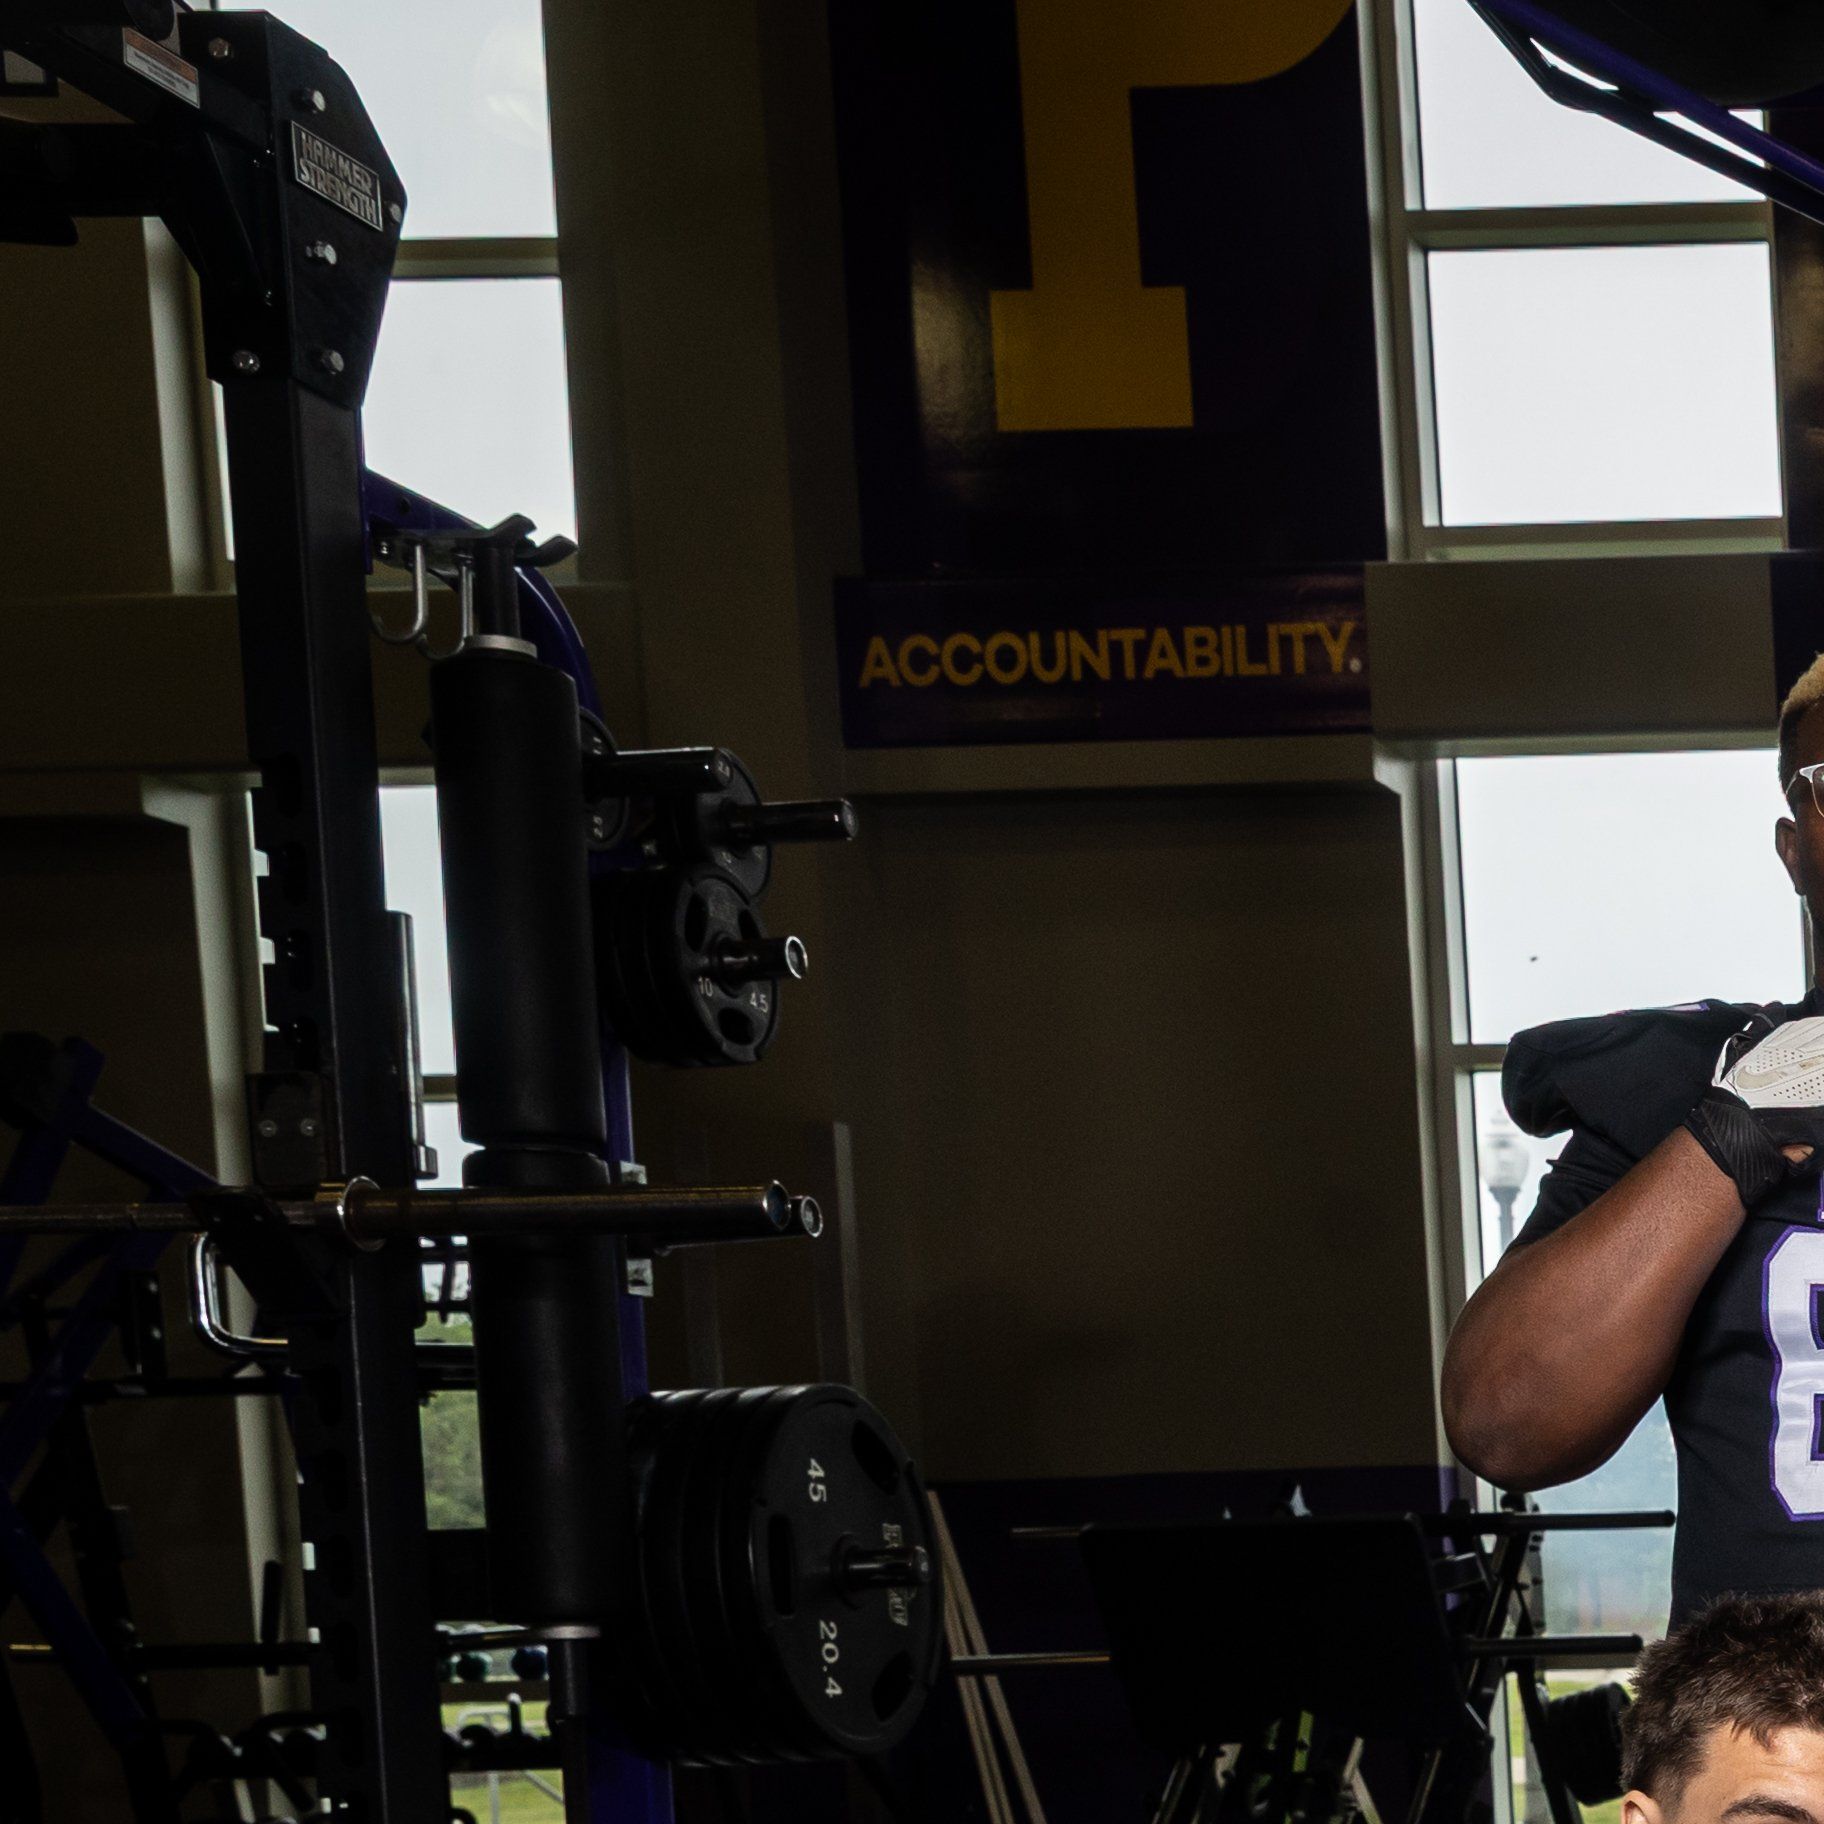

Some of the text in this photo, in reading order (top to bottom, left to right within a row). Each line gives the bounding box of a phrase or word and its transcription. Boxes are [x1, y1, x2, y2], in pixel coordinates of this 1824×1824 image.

[299, 157, 378, 226] STRENGTH
[301, 130, 372, 193] HAMMER
[858, 621, 1364, 688] ACCOUNTABILITY.
[807, 1457, 828, 1504] 45
[819, 1619, 844, 1699] 20.4
